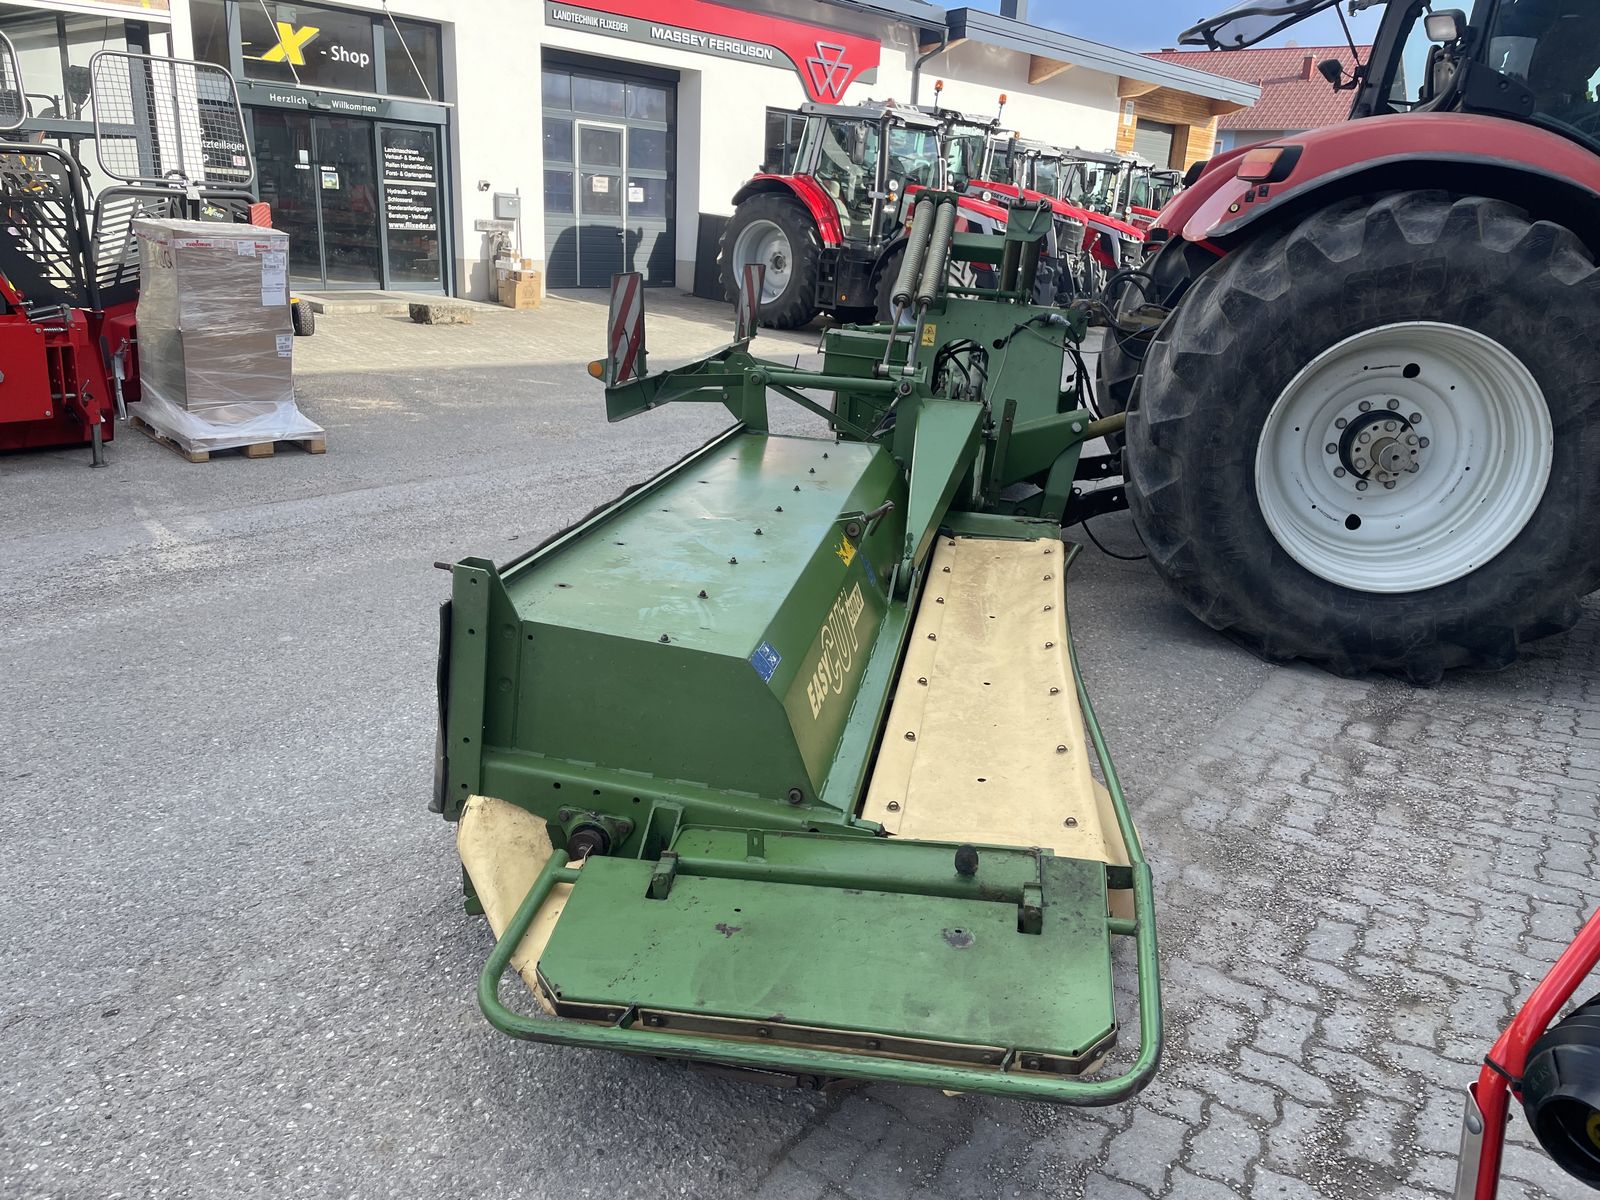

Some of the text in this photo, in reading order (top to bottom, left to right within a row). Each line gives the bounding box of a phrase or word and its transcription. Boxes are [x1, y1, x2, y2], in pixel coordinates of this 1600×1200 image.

[553, 9, 629, 33] LANDTECHNIK FLIXEDER
[651, 26, 773, 60] MASSEY FERGUSON
[330, 45, 370, 68] Shop
[269, 93, 377, 112] Herzlich Willkommen
[384, 146, 419, 155] Landmaschinen
[388, 212, 409, 220] Beratung
[388, 221, 436, 230] www.flixeder.at
